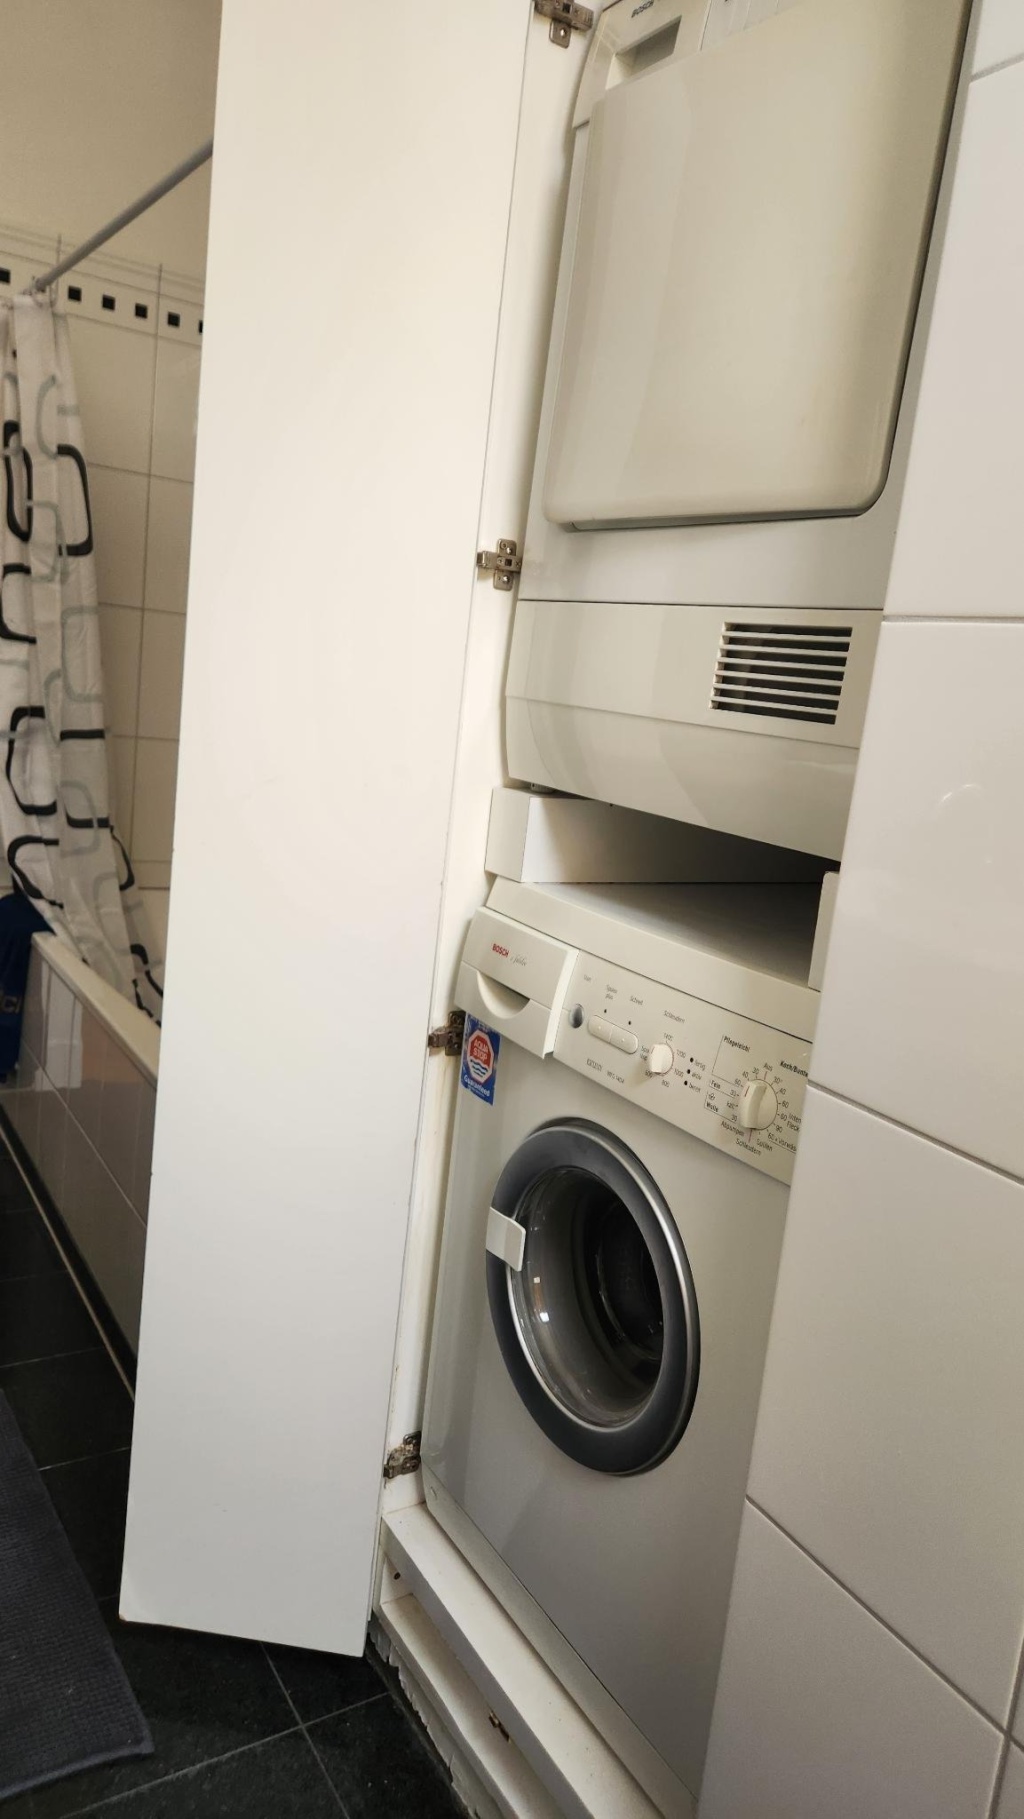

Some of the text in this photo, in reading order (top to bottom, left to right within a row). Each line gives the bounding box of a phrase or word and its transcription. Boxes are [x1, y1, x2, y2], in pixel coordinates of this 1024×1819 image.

[492, 943, 510, 958] BOSCH
[473, 1039, 489, 1053] AQUA
[473, 1047, 488, 1062] STOP
